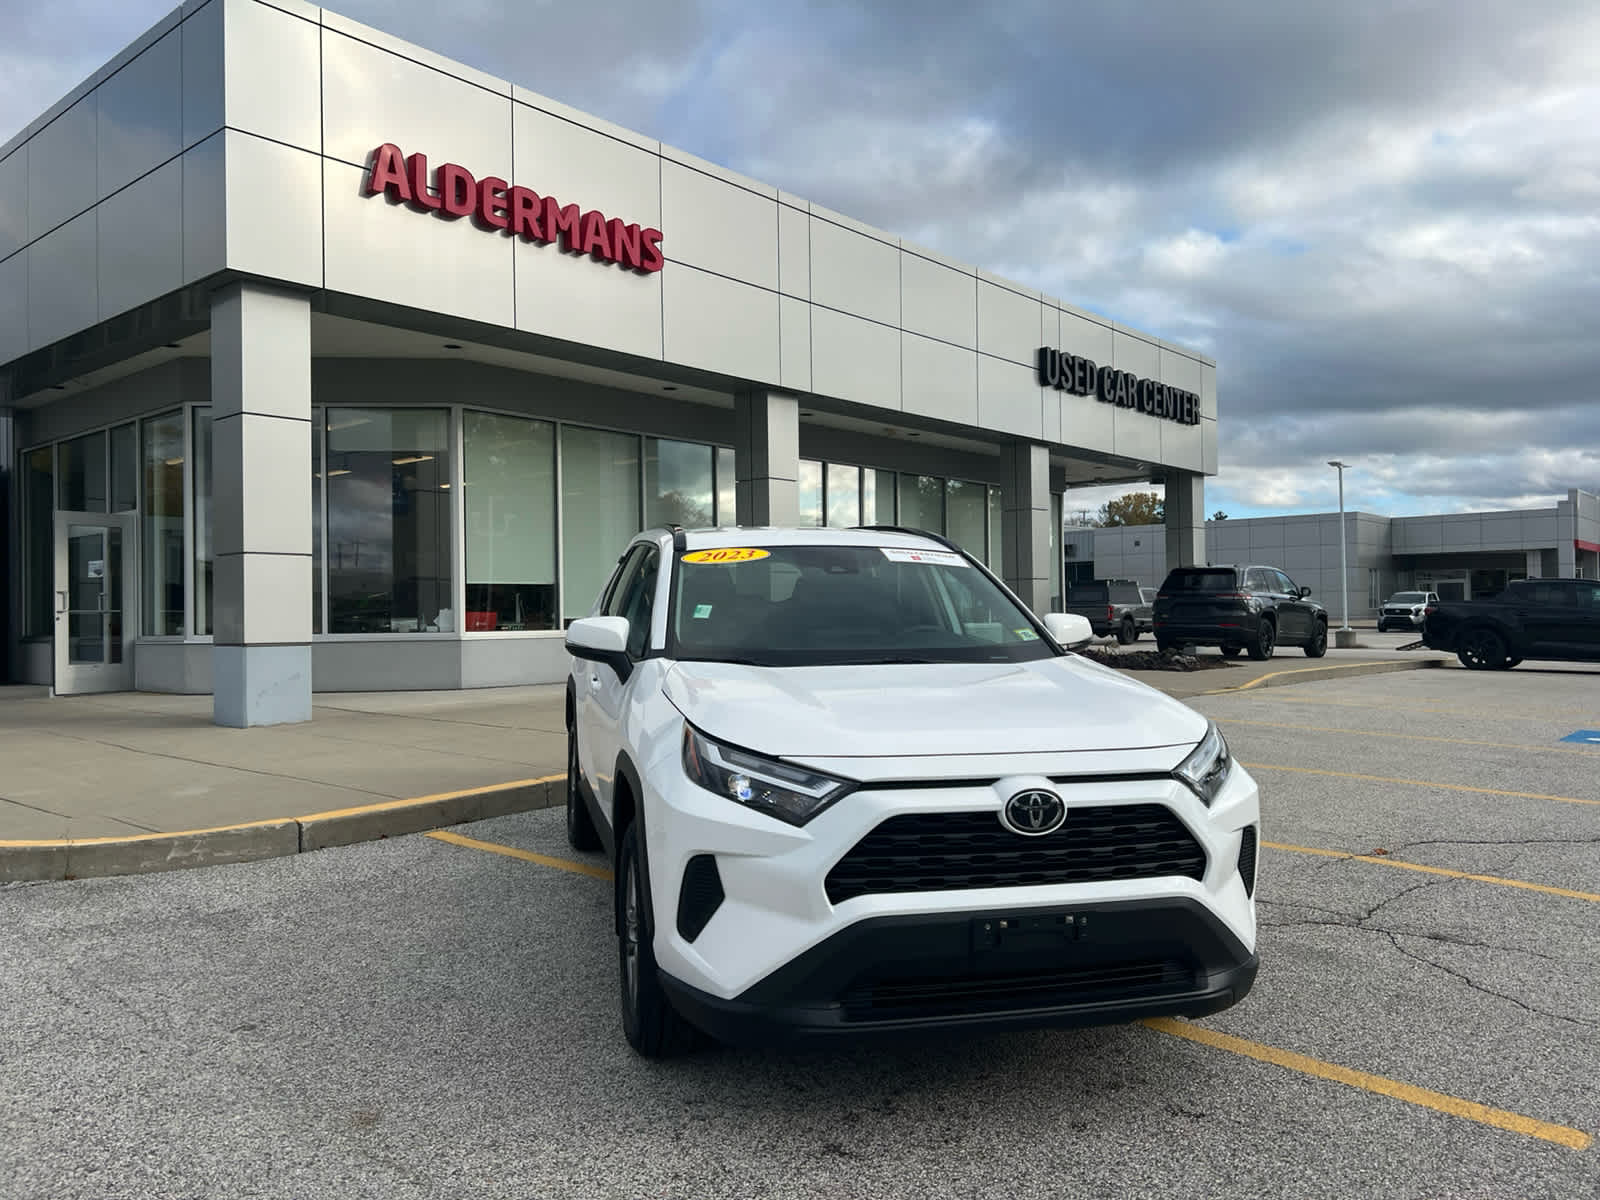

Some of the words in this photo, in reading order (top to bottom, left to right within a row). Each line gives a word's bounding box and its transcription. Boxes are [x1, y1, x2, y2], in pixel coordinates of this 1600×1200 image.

[367, 143, 664, 272] ALDERMANS
[1040, 347, 1097, 396] USED
[1099, 366, 1138, 408] CAR
[1138, 379, 1200, 425] CENTER
[698, 550, 756, 562] 2023
